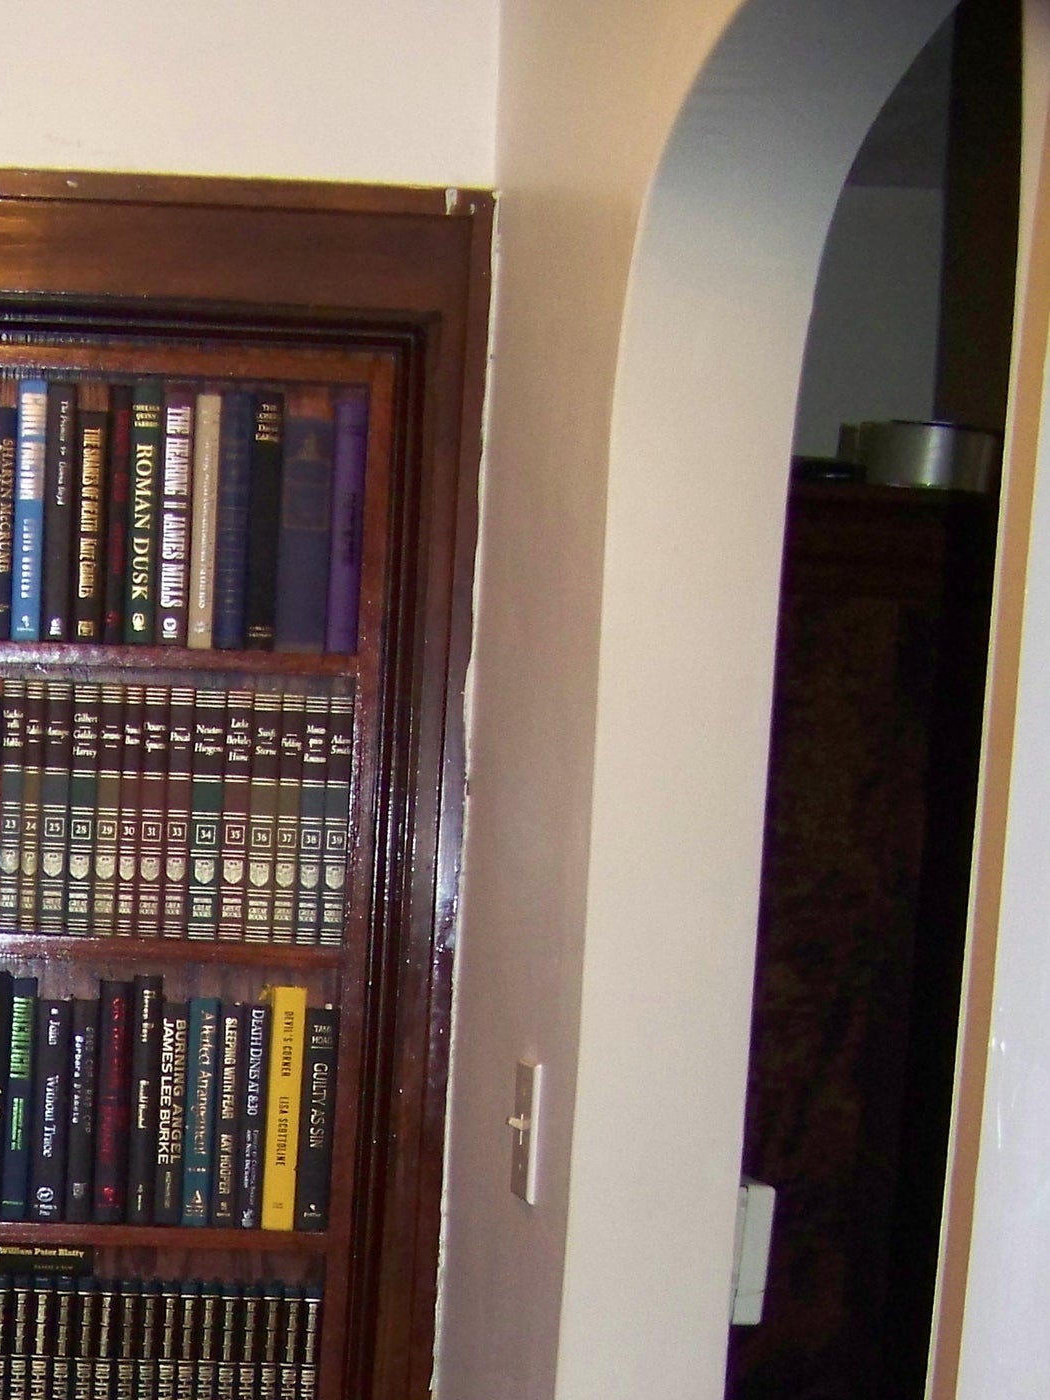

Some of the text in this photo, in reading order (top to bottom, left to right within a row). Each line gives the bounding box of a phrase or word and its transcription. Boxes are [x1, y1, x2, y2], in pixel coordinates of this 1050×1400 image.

[162, 406, 191, 497] THE HEARING
[79, 428, 101, 532] THE SNARES OF DEATH
[130, 444, 154, 602] ROMAN DUSK
[78, 537, 97, 560] KATE
[159, 513, 187, 609] JAMES MILLS
[48, 822, 61, 833] 25
[75, 823, 89, 835] 28
[102, 824, 116, 836] 29
[124, 825, 135, 837] 30
[146, 826, 157, 838] 31
[199, 829, 212, 840] 34
[229, 829, 241, 840] 35
[256, 831, 268, 843] 36
[281, 832, 293, 844] 37
[304, 832, 317, 845] 38
[198, 1024, 218, 1066] Perfect
[247, 1008, 266, 1095] DEATH DINES AT
[221, 1017, 239, 1120] SLEEPING WITH FEAR
[274, 1010, 295, 1168] DEVIL'S CORNER LISA SCOTTOLINE
[157, 1017, 175, 1165] JAMES LEE BURKE
[170, 1018, 188, 1165] BURNING ANGEL
[308, 1061, 330, 1150] GUILTY AS SIN
[41, 1074, 60, 1158] Without Trace
[218, 1133, 232, 1195] KAY HOOPER
[32, 1247, 58, 1258] Peter
[57, 1248, 86, 1261] Blatty
